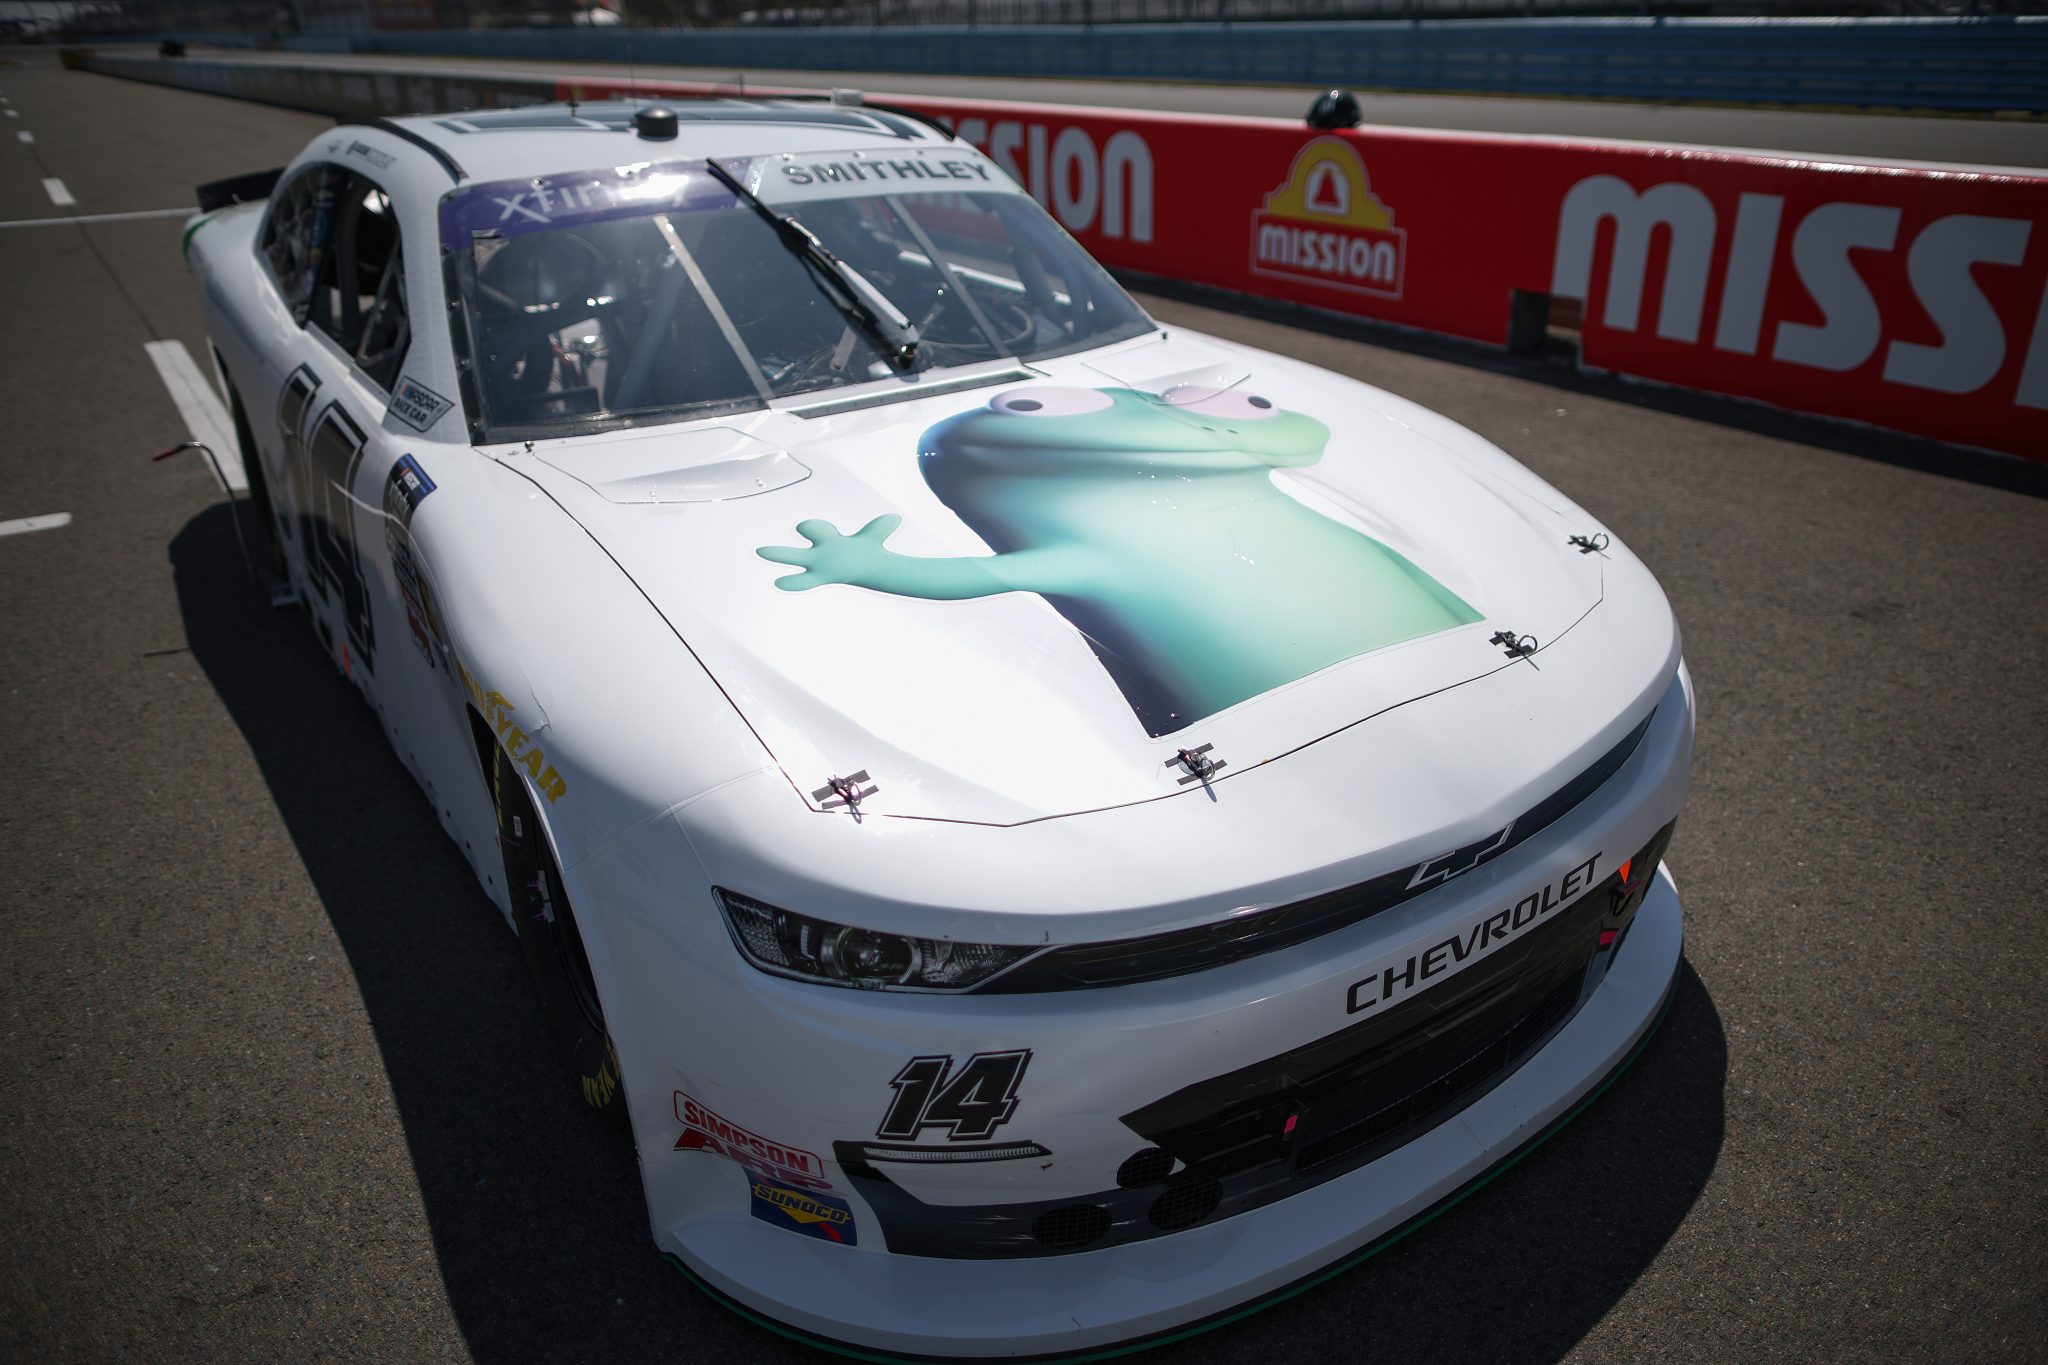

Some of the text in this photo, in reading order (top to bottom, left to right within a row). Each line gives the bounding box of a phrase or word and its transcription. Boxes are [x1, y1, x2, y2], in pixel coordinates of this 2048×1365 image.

[782, 160, 992, 186] SMITHLEY
[409, 407, 428, 425] CAR
[1346, 851, 1602, 1015] CHEVROLET
[875, 1048, 1032, 1141] 14
[684, 1100, 810, 1173] SIMPSON
[756, 1184, 846, 1223] SUNOCO
